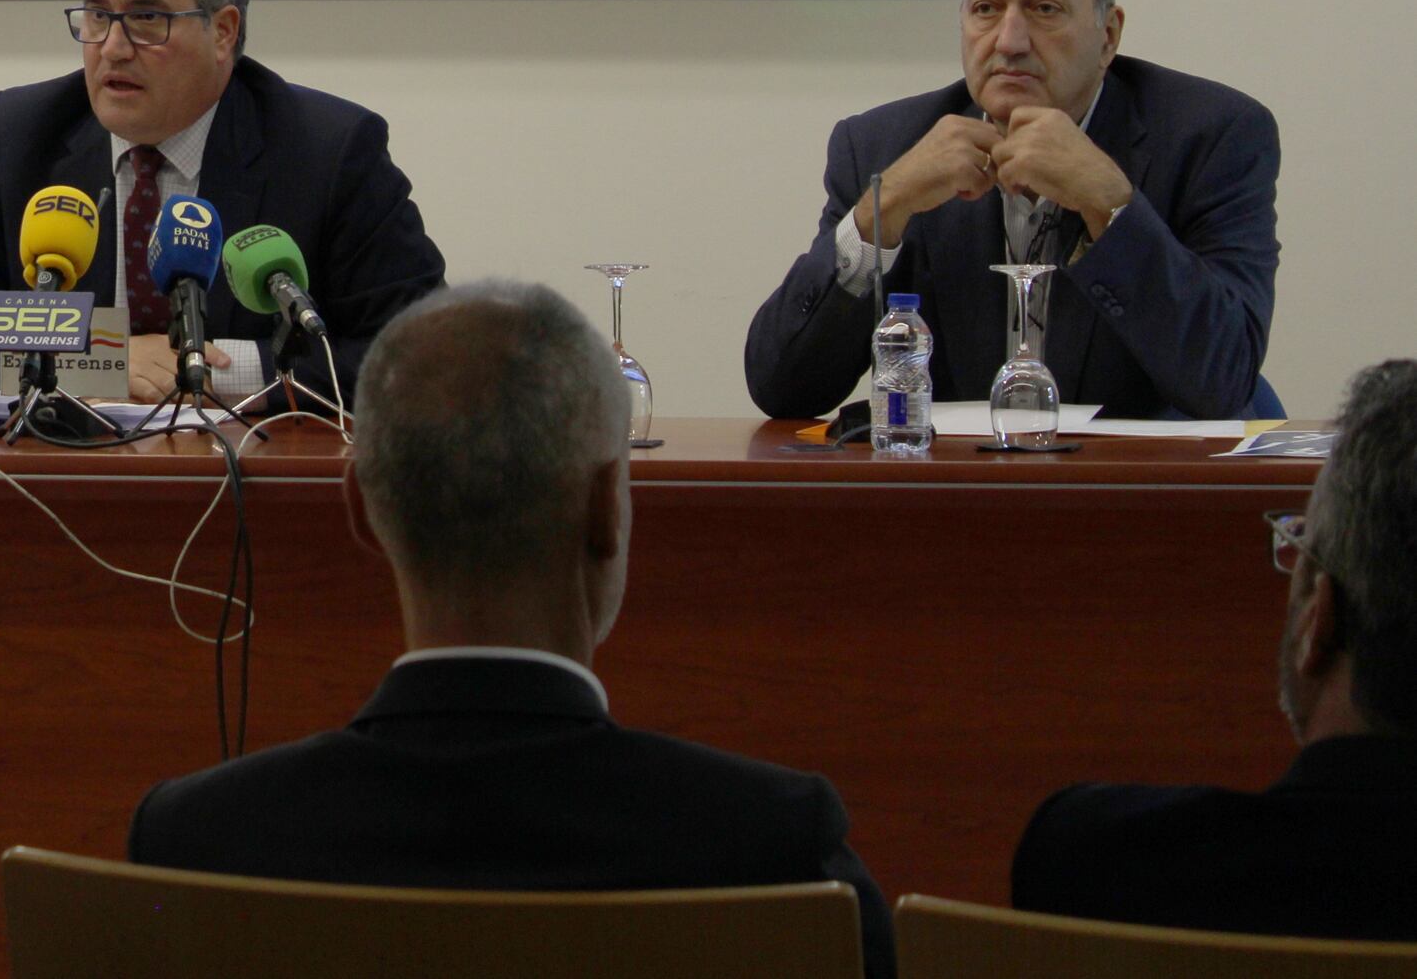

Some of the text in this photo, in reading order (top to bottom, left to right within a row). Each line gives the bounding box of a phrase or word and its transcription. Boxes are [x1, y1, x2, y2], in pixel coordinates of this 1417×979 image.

[34, 195, 96, 229] SER
[174, 227, 210, 241] BADAL
[173, 236, 209, 251] NOVAS
[5, 298, 68, 306] CADENA
[23, 336, 80, 346] OURENSE
[3, 354, 125, 370] Exurense
